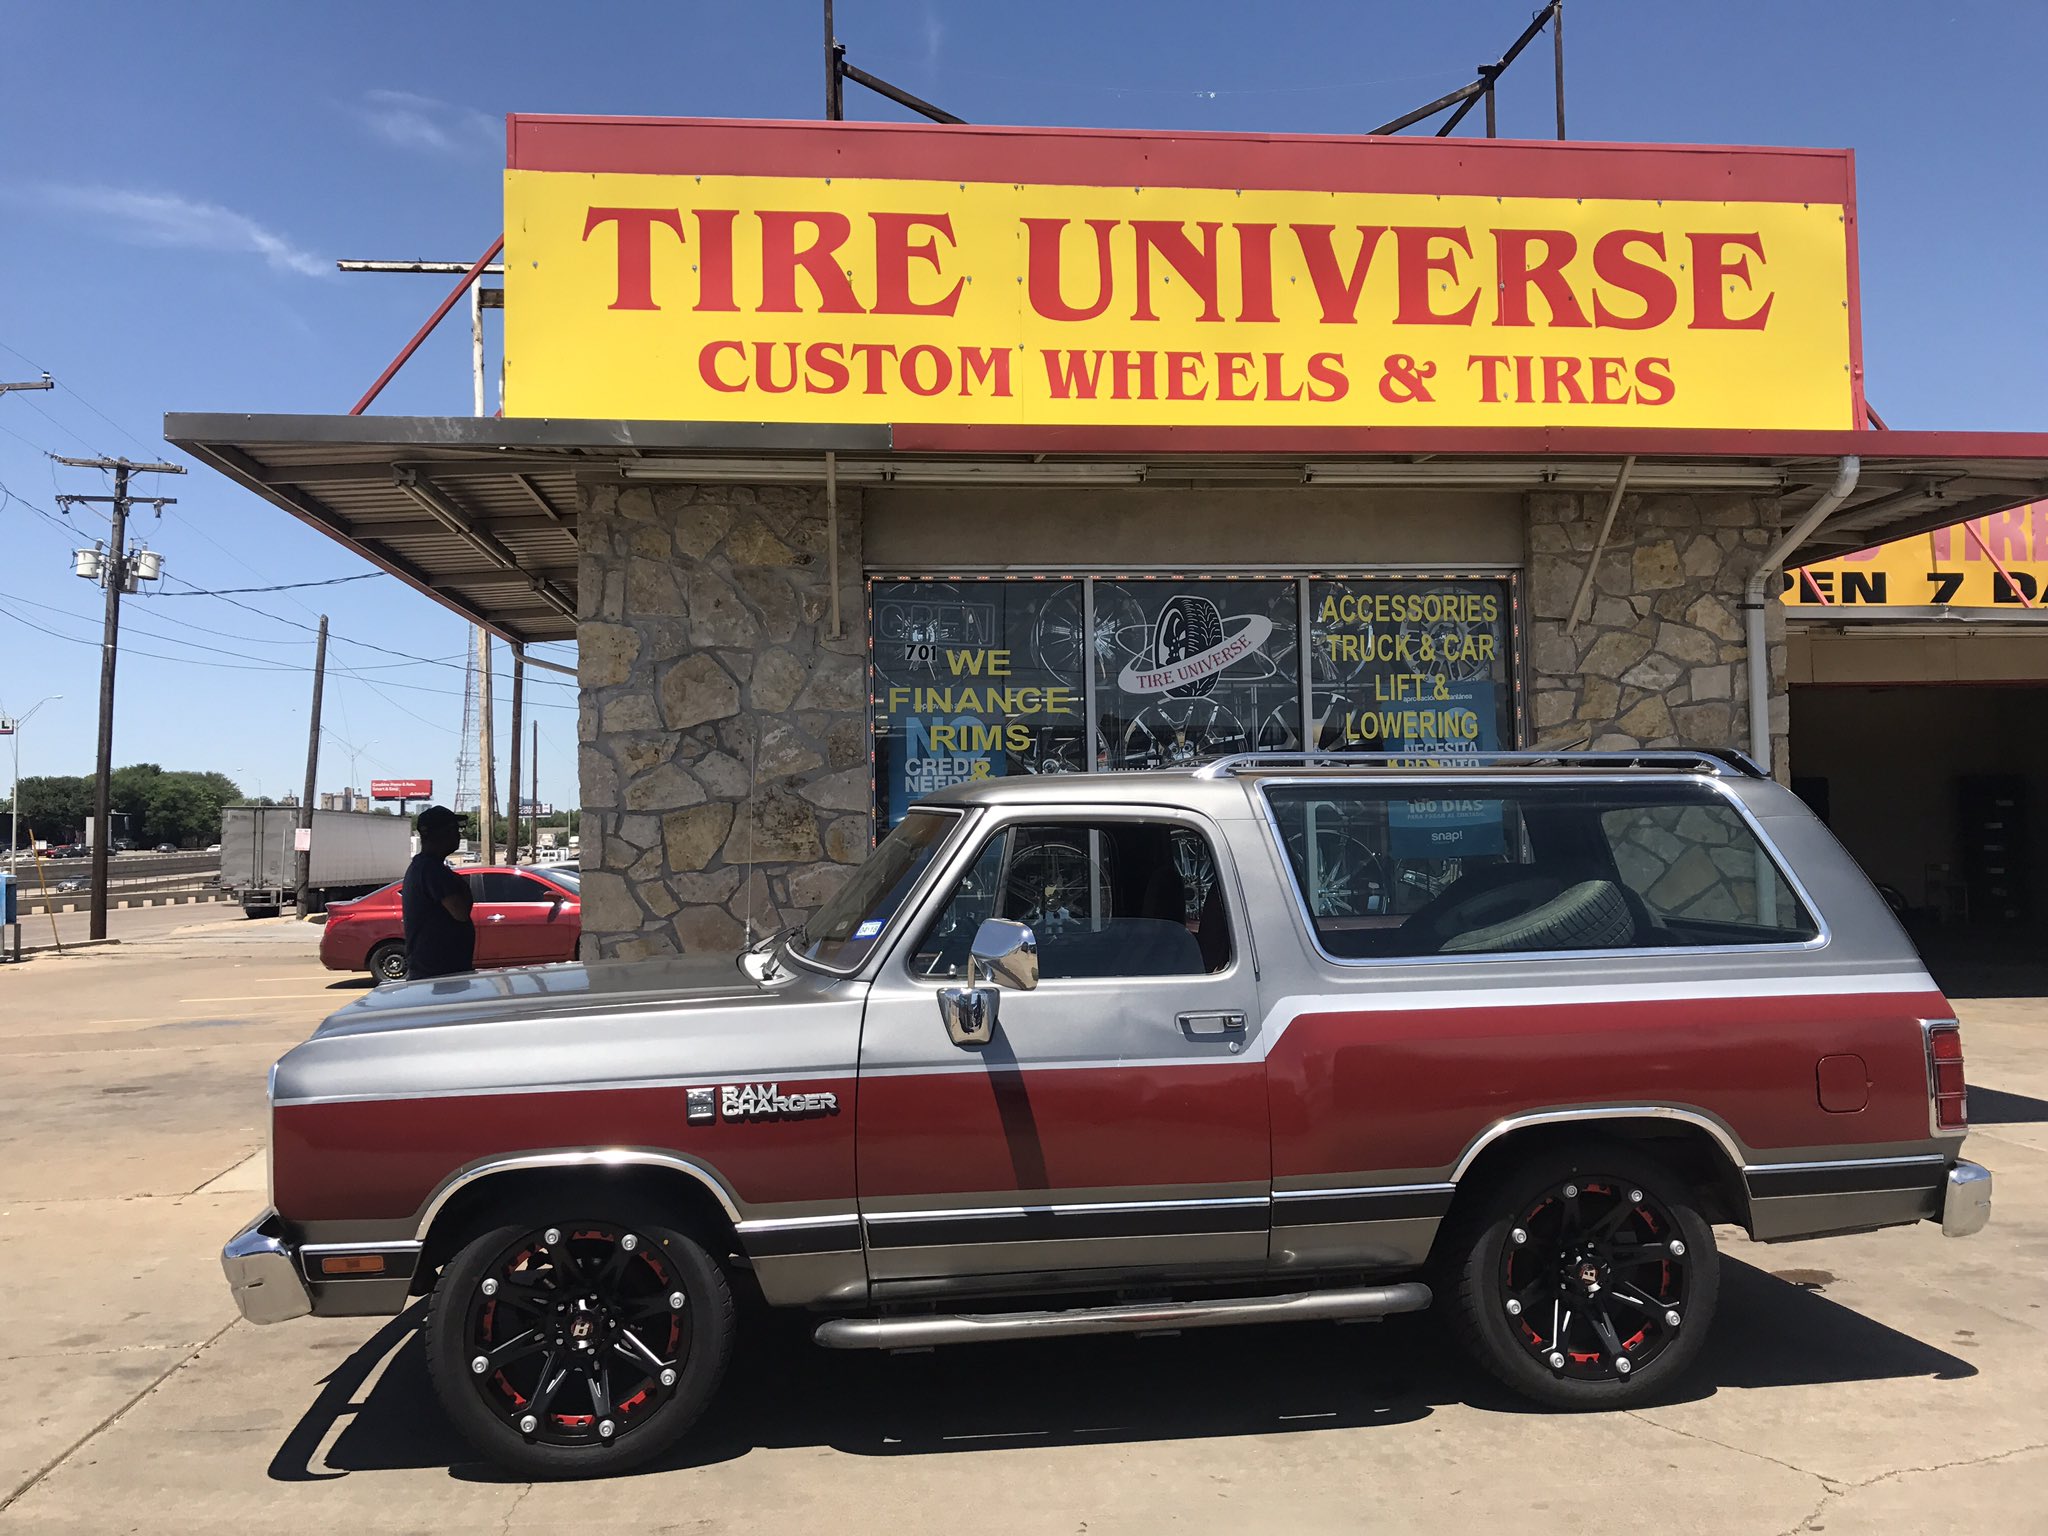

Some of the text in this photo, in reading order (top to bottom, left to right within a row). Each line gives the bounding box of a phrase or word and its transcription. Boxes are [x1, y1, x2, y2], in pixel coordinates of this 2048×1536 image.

[582, 205, 1775, 332] TIRE UNIVERSE
[698, 340, 1676, 405] CUSTOM WHEELS & TIRES
[1927, 572, 1964, 604] 7
[1993, 571, 2048, 604] D
[1321, 594, 1498, 622] ACCESSORIES
[906, 644, 937, 661] 701
[1328, 633, 1496, 662] TRUCK & CAR
[945, 649, 1012, 676] WE
[1136, 634, 1252, 690] TIRE UNIVERSE
[889, 687, 1072, 714] FINANCE
[1375, 673, 1450, 701] LIFT &
[930, 725, 1031, 751] RIMS
[1346, 711, 1479, 739] LOWERING
[970, 761, 996, 782] &
[1407, 800, 1437, 813] 100
[1431, 830, 1463, 842] snap!
[721, 1082, 779, 1101] RAM
[722, 1092, 837, 1117] CHARGER
